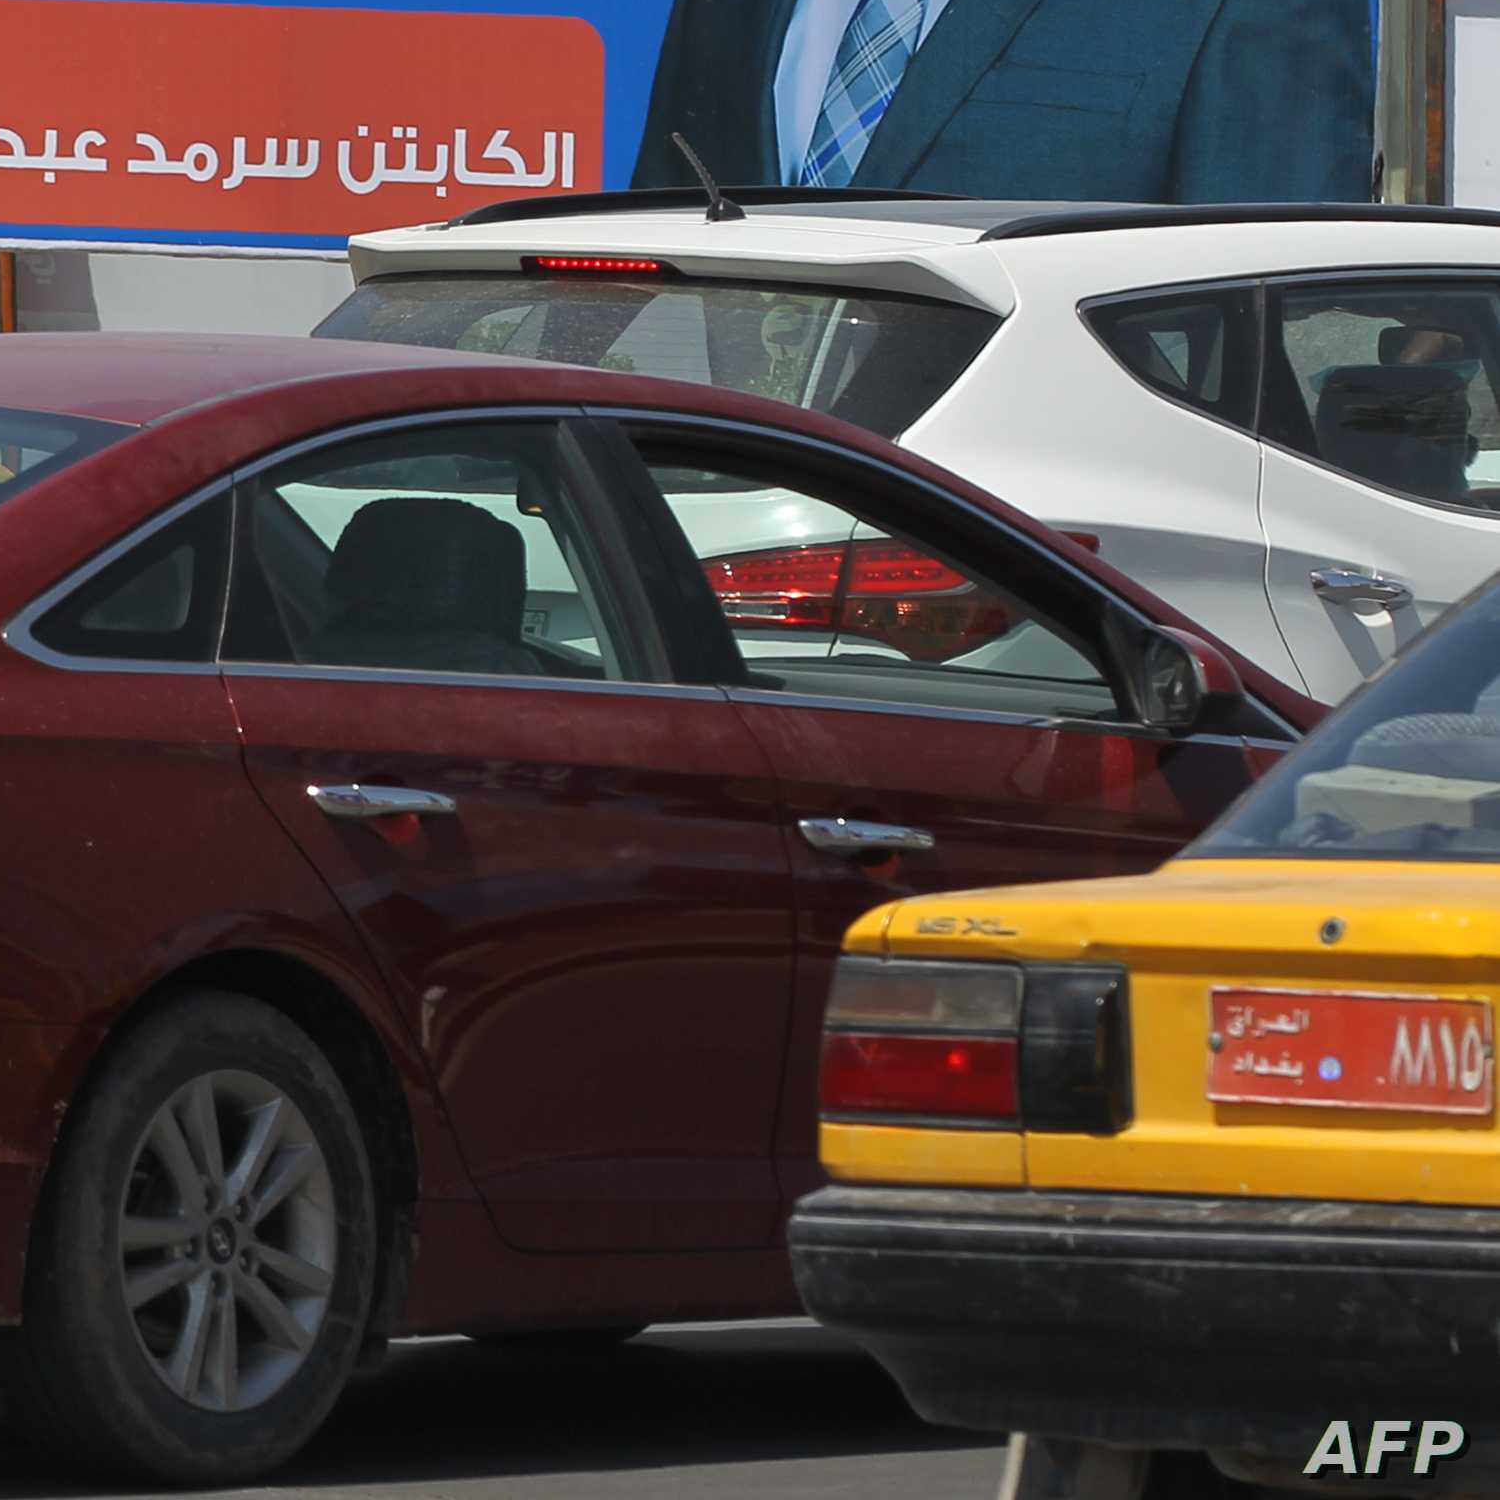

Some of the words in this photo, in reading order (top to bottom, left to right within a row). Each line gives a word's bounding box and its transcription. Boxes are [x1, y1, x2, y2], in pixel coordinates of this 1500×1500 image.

[124, 129, 321, 190] سرمد
[335, 123, 577, 198] الكابتن
[1225, 1005, 1311, 1038] العراق
[1232, 1051, 1305, 1086] بغداد
